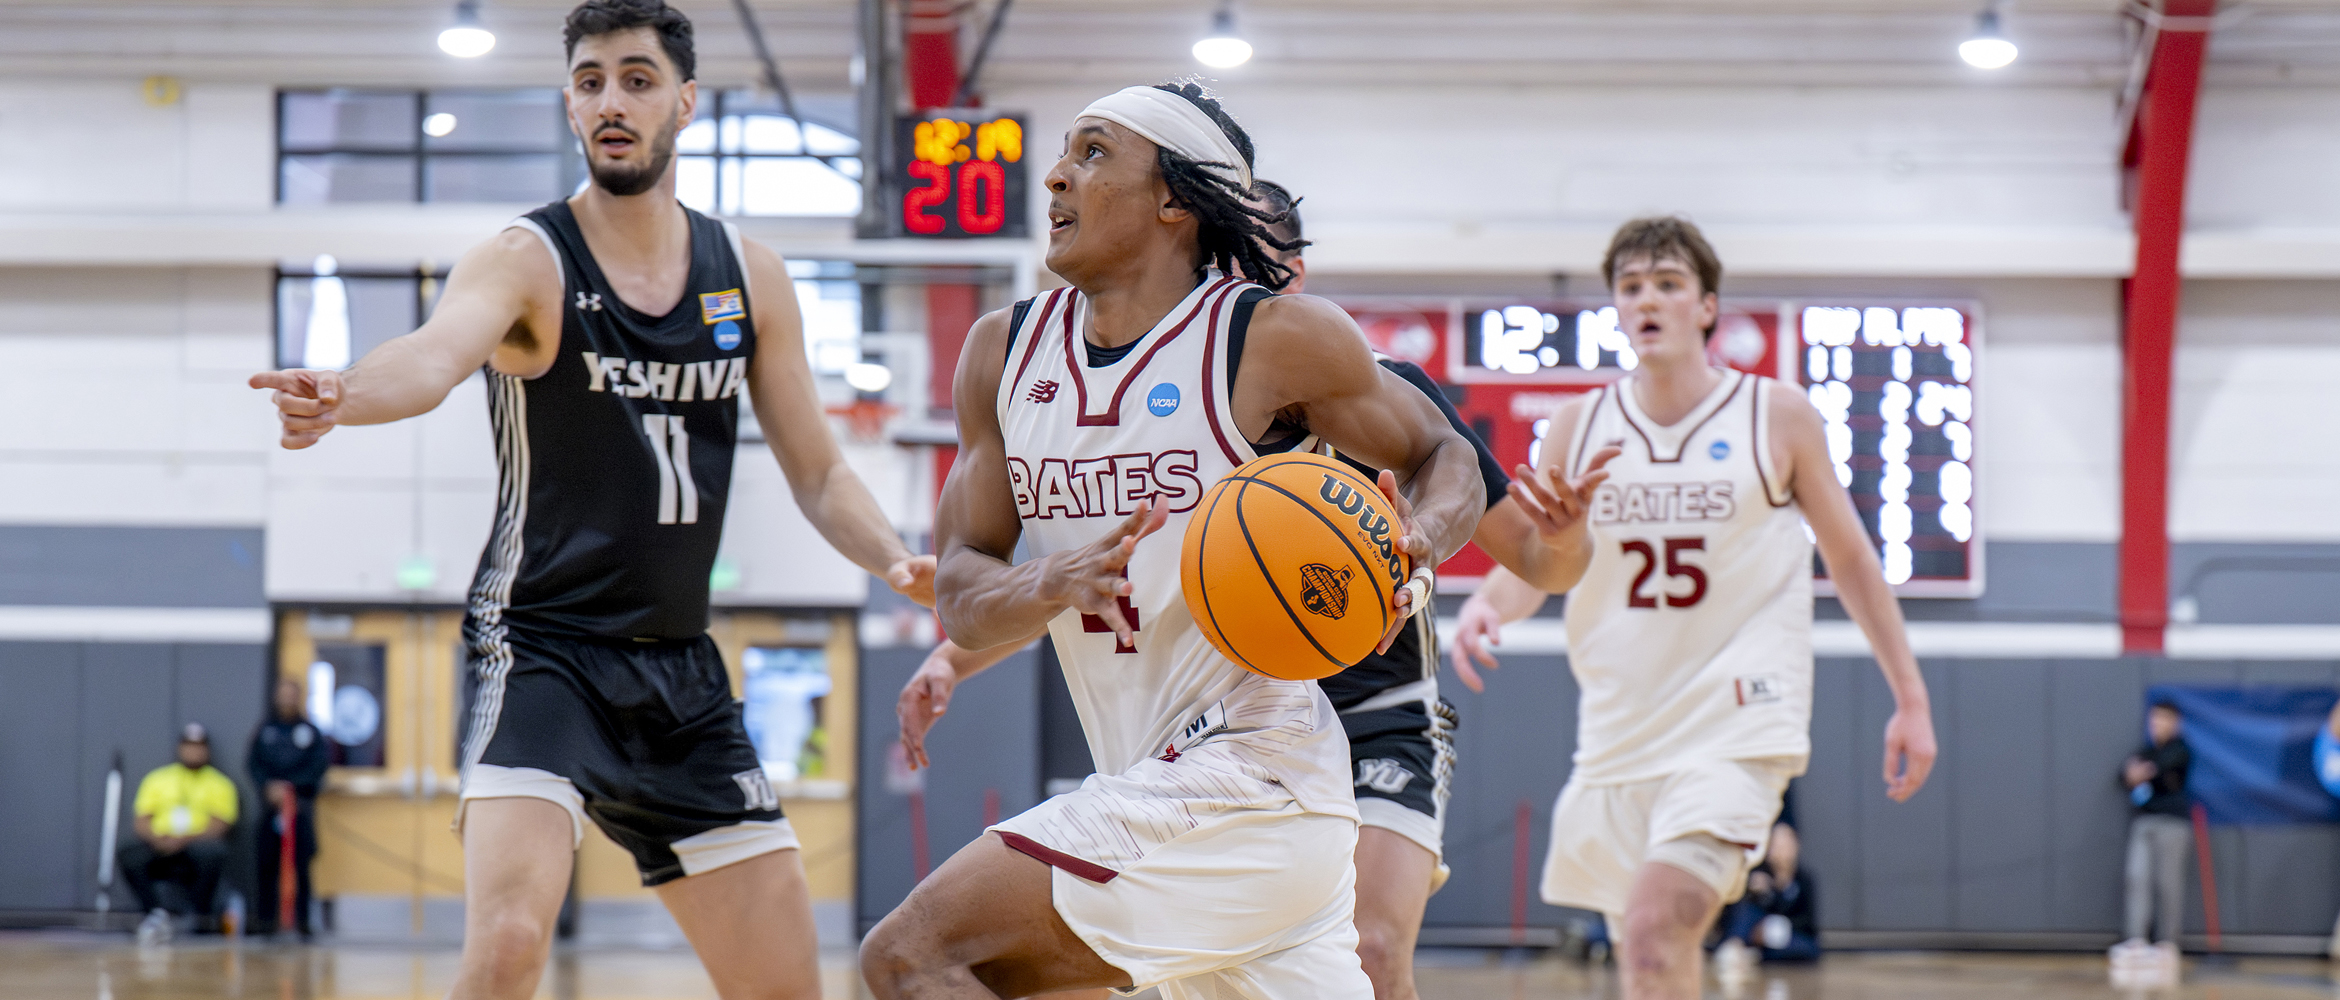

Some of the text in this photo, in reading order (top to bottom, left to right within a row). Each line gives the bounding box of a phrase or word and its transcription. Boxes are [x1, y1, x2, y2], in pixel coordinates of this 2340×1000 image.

[903, 159, 1005, 234] 20
[581, 351, 747, 402] YESHIVA
[1150, 398, 1178, 408] NCAA
[642, 414, 698, 524] 11
[1007, 450, 1204, 519] BATES
[1592, 479, 1735, 524] BATES
[1357, 531, 1386, 568] EVO NXT
[1620, 536, 1708, 609] 25
[1301, 565, 1344, 618] CHAMPIONSHIP
[731, 767, 779, 812] YU
[1353, 757, 1415, 794] YU
